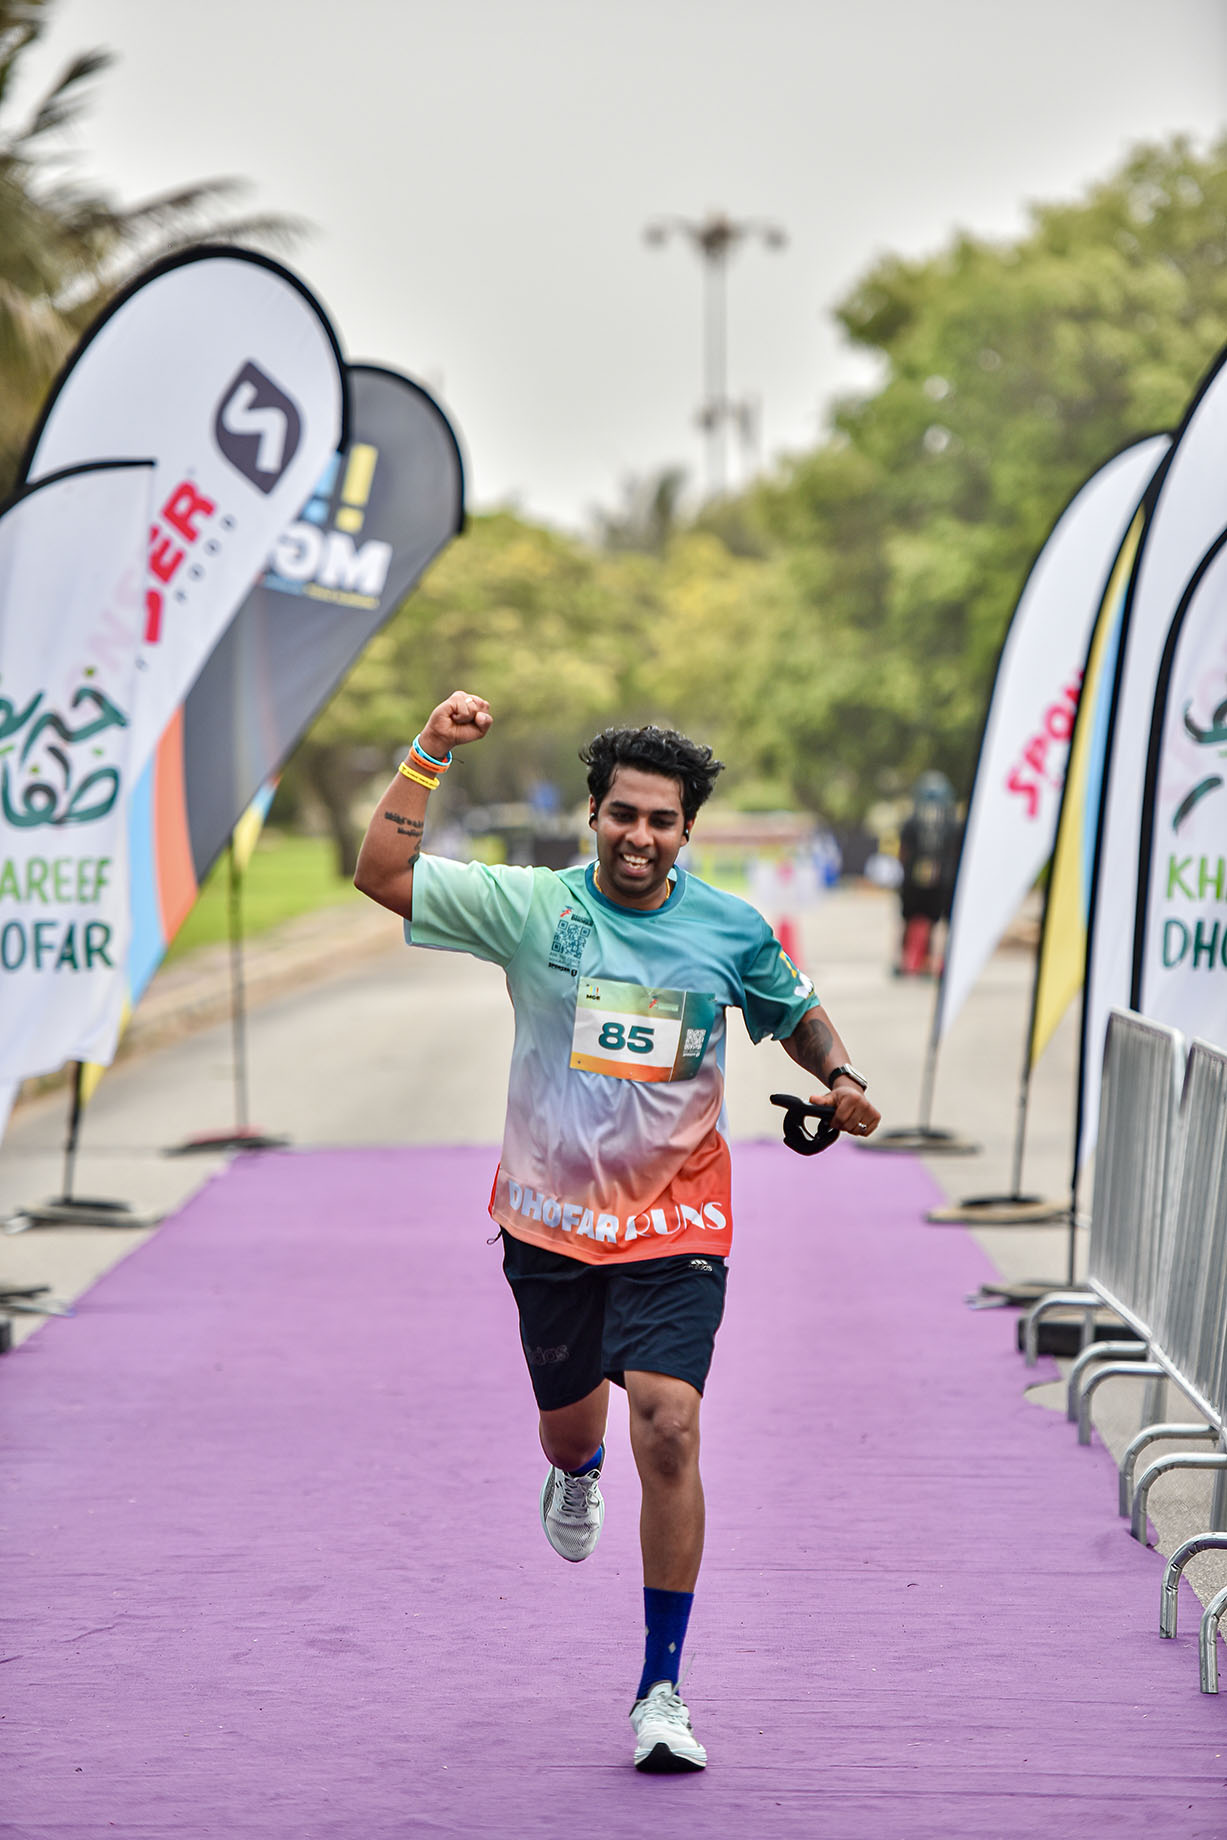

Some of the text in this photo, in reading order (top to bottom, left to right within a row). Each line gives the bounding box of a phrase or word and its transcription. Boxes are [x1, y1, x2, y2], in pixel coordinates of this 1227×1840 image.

[1007, 670, 1083, 820] SPO
[0, 857, 112, 904] AREEF
[1167, 854, 1227, 901] KH
[0, 920, 114, 972] OFAR
[598, 1022, 655, 1054] 85
[508, 1180, 727, 1244] DHOFAR RUNS
